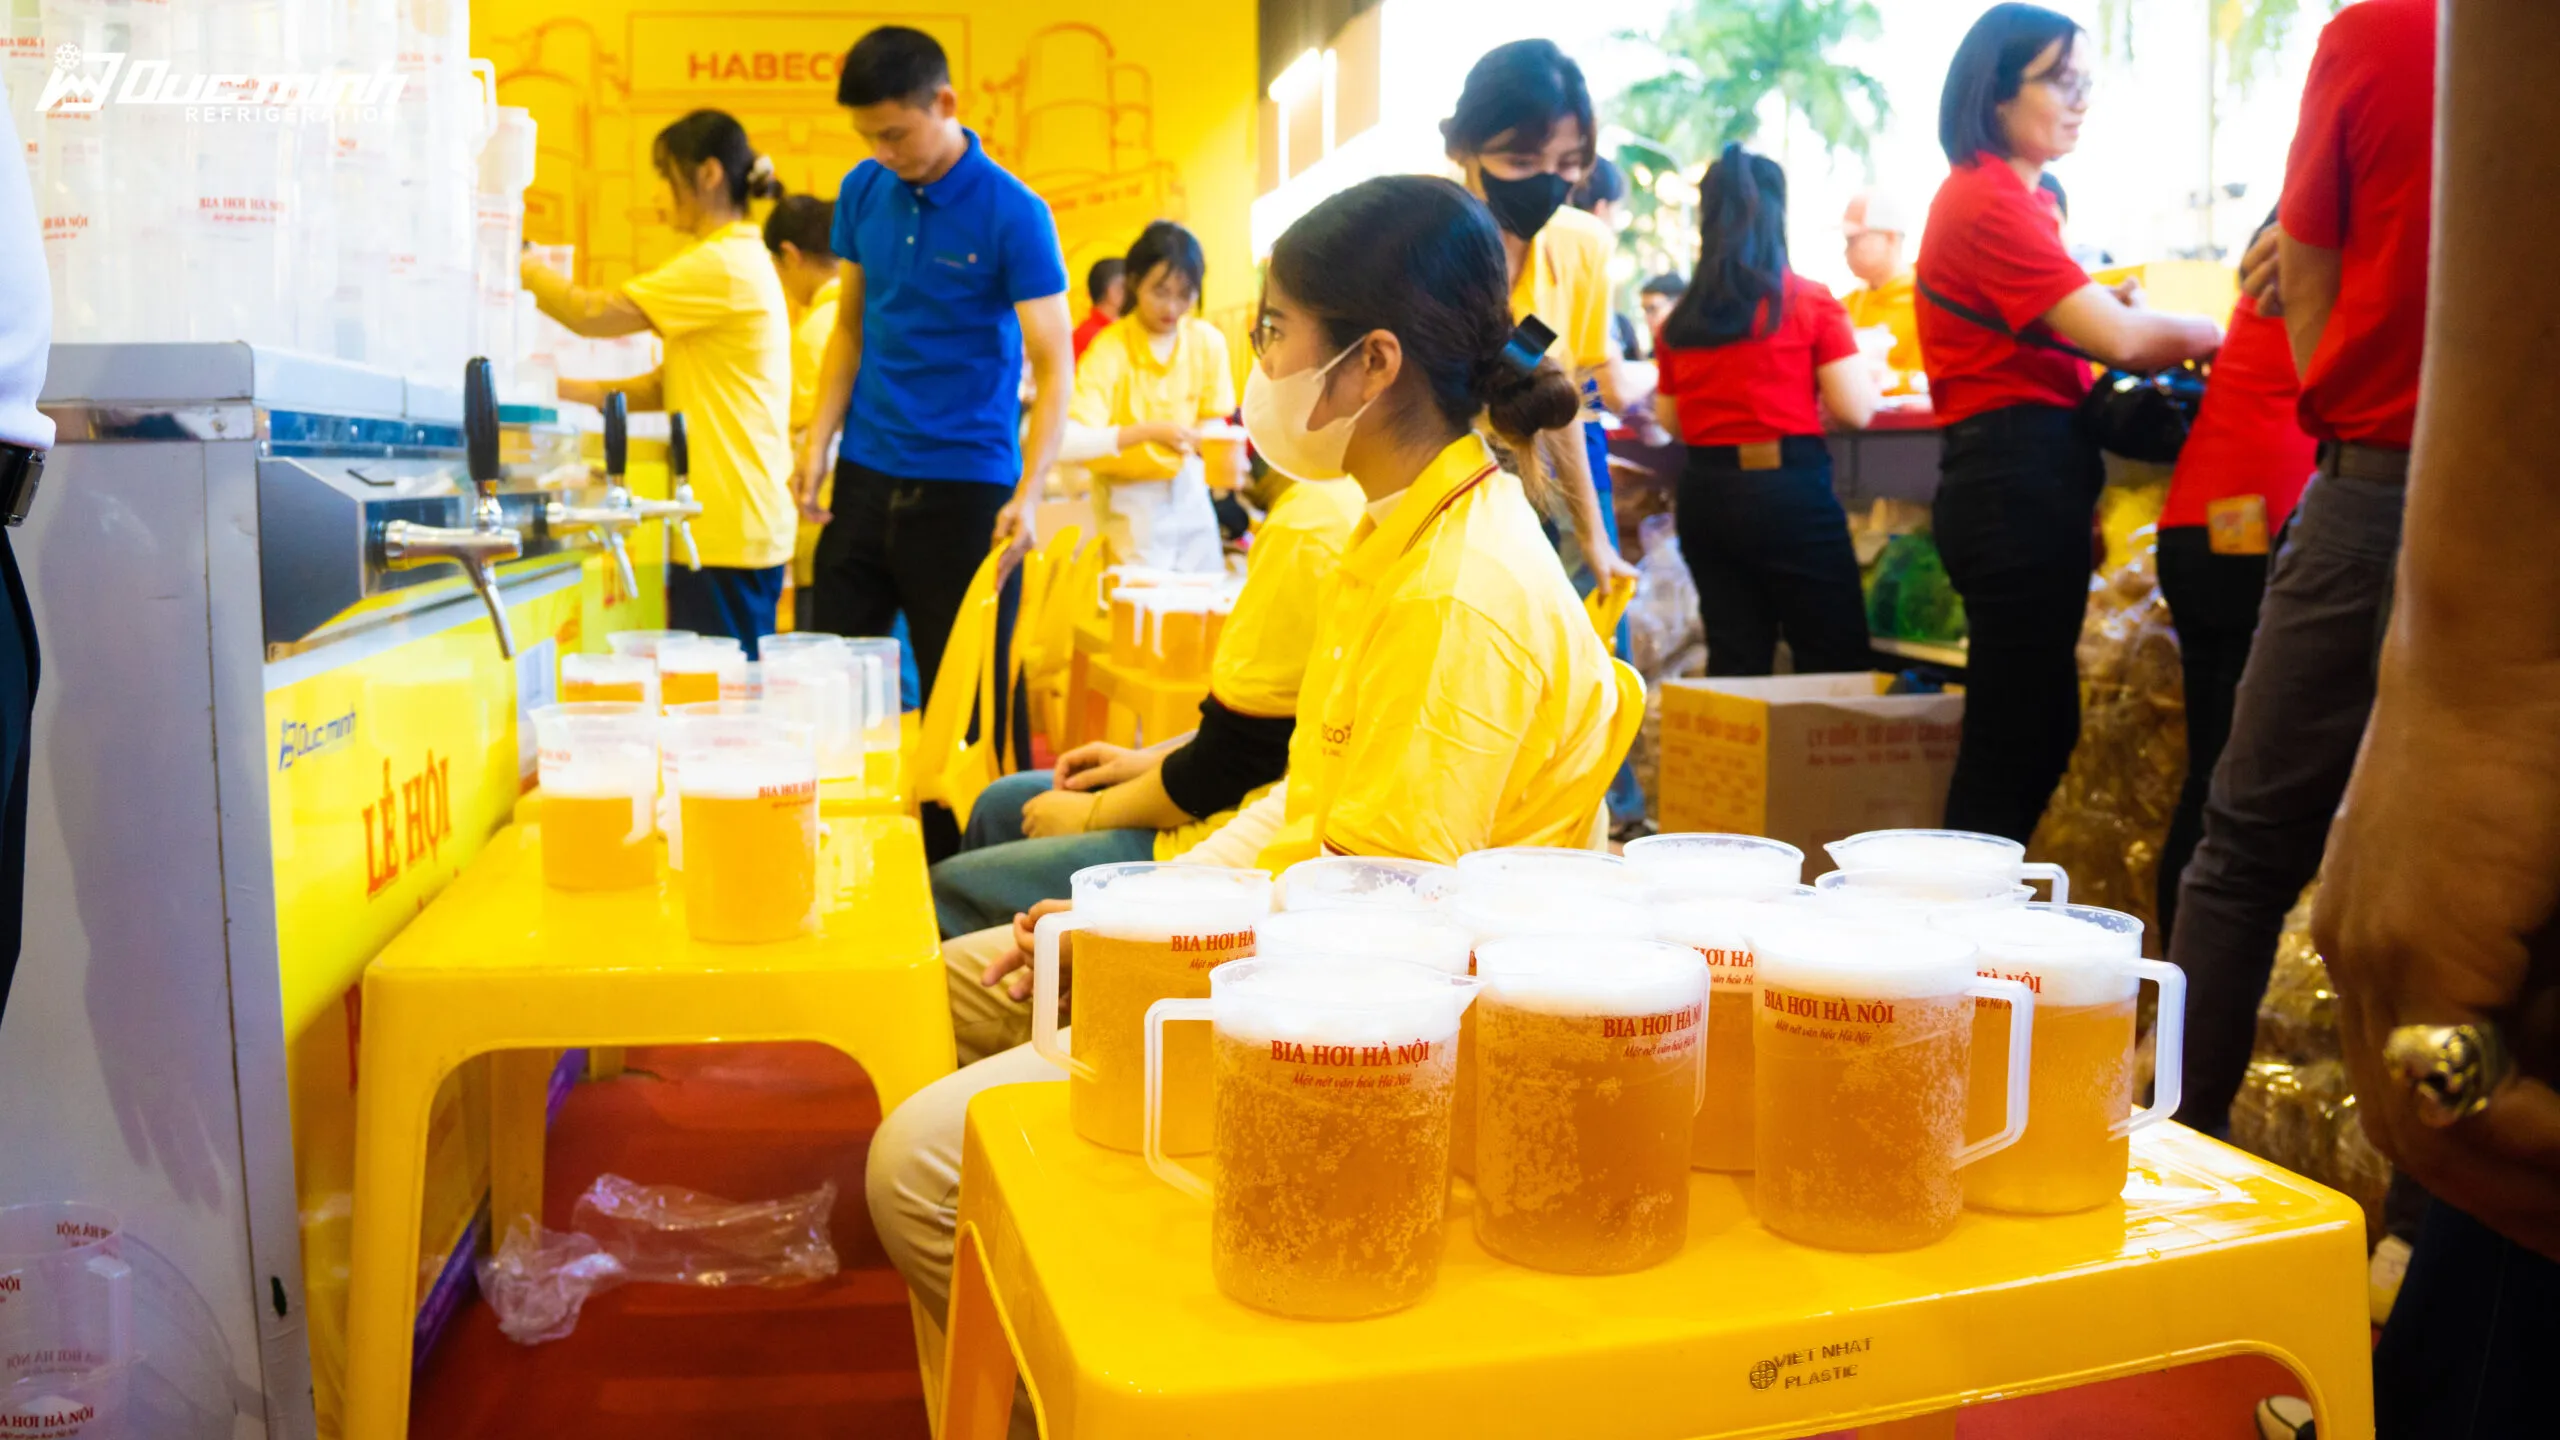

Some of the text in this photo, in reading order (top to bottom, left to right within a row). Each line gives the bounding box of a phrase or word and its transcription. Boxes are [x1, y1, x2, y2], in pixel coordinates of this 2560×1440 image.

[1171, 935, 1202, 952] BIA
[1205, 932, 1236, 952] HƠI
[1603, 1018, 1637, 1038] BIA
[1641, 1013, 1673, 1036] HƠI
[1676, 1004, 1692, 1031] HÀ
[1764, 989, 1895, 1028] BIA HƠI HÀ NỘI
[1271, 1038, 1430, 1068] BIA HƠI HÀ NỘI
[1784, 1364, 1858, 1389] PLASTIC
[44, 1410, 65, 1428] HÀ
[68, 1404, 94, 1424] NỘI
